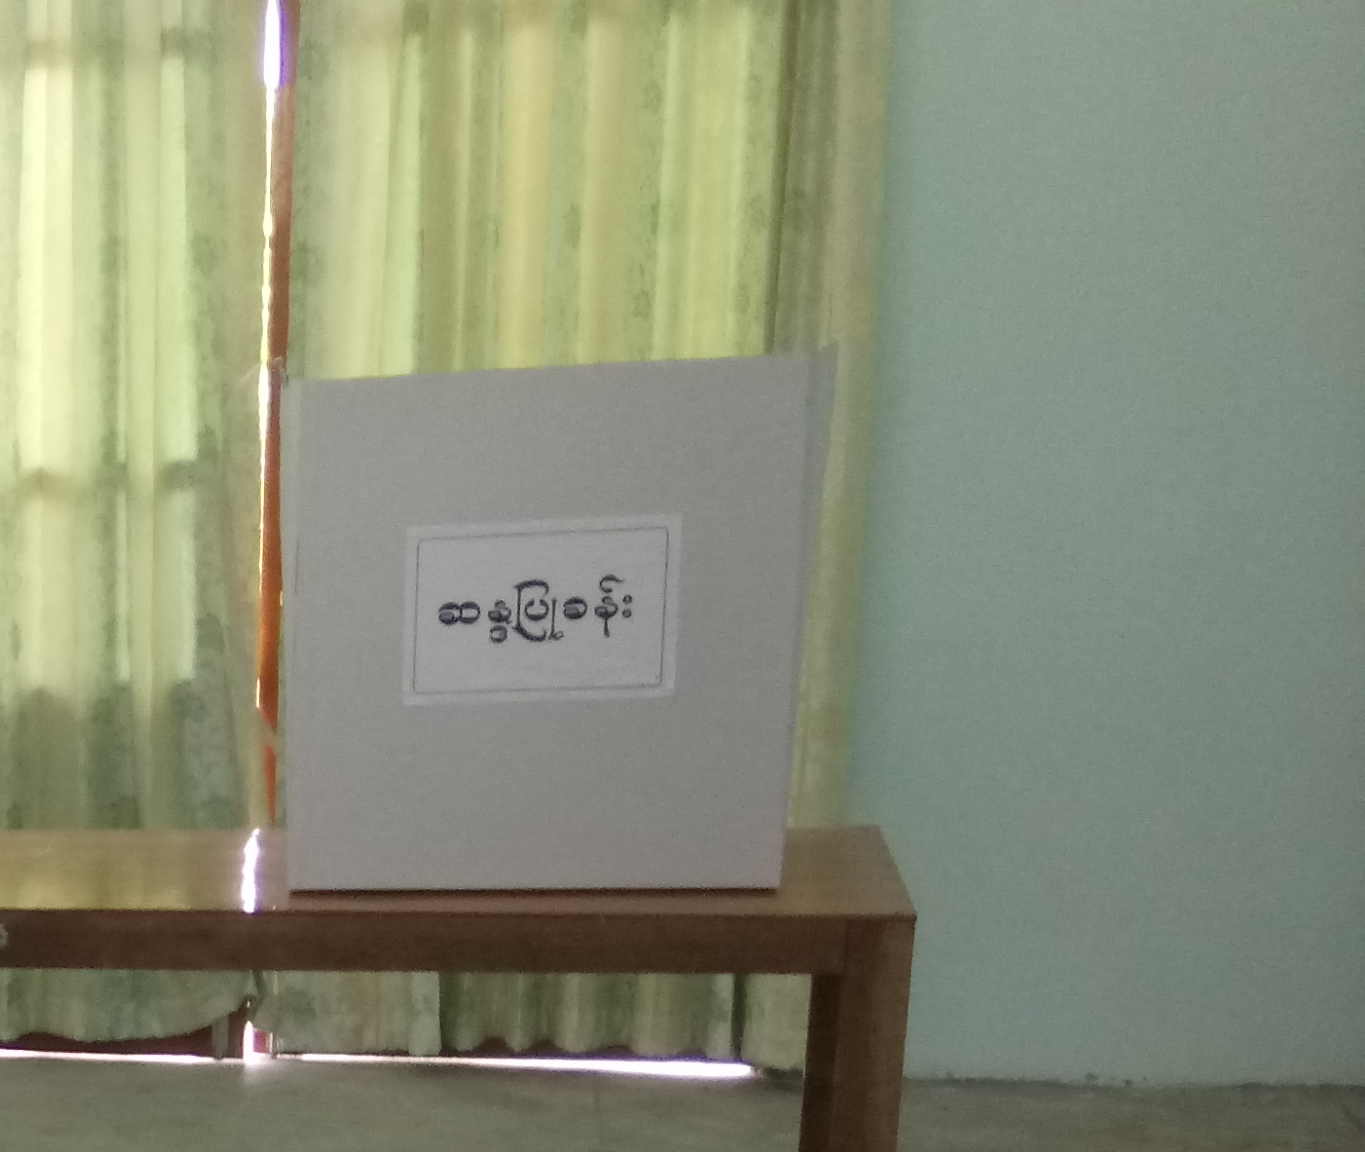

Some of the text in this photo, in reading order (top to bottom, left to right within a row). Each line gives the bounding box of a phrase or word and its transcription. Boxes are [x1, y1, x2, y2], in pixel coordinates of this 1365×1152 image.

[437, 573, 634, 645] ဆန္ဒပြုခန်း
